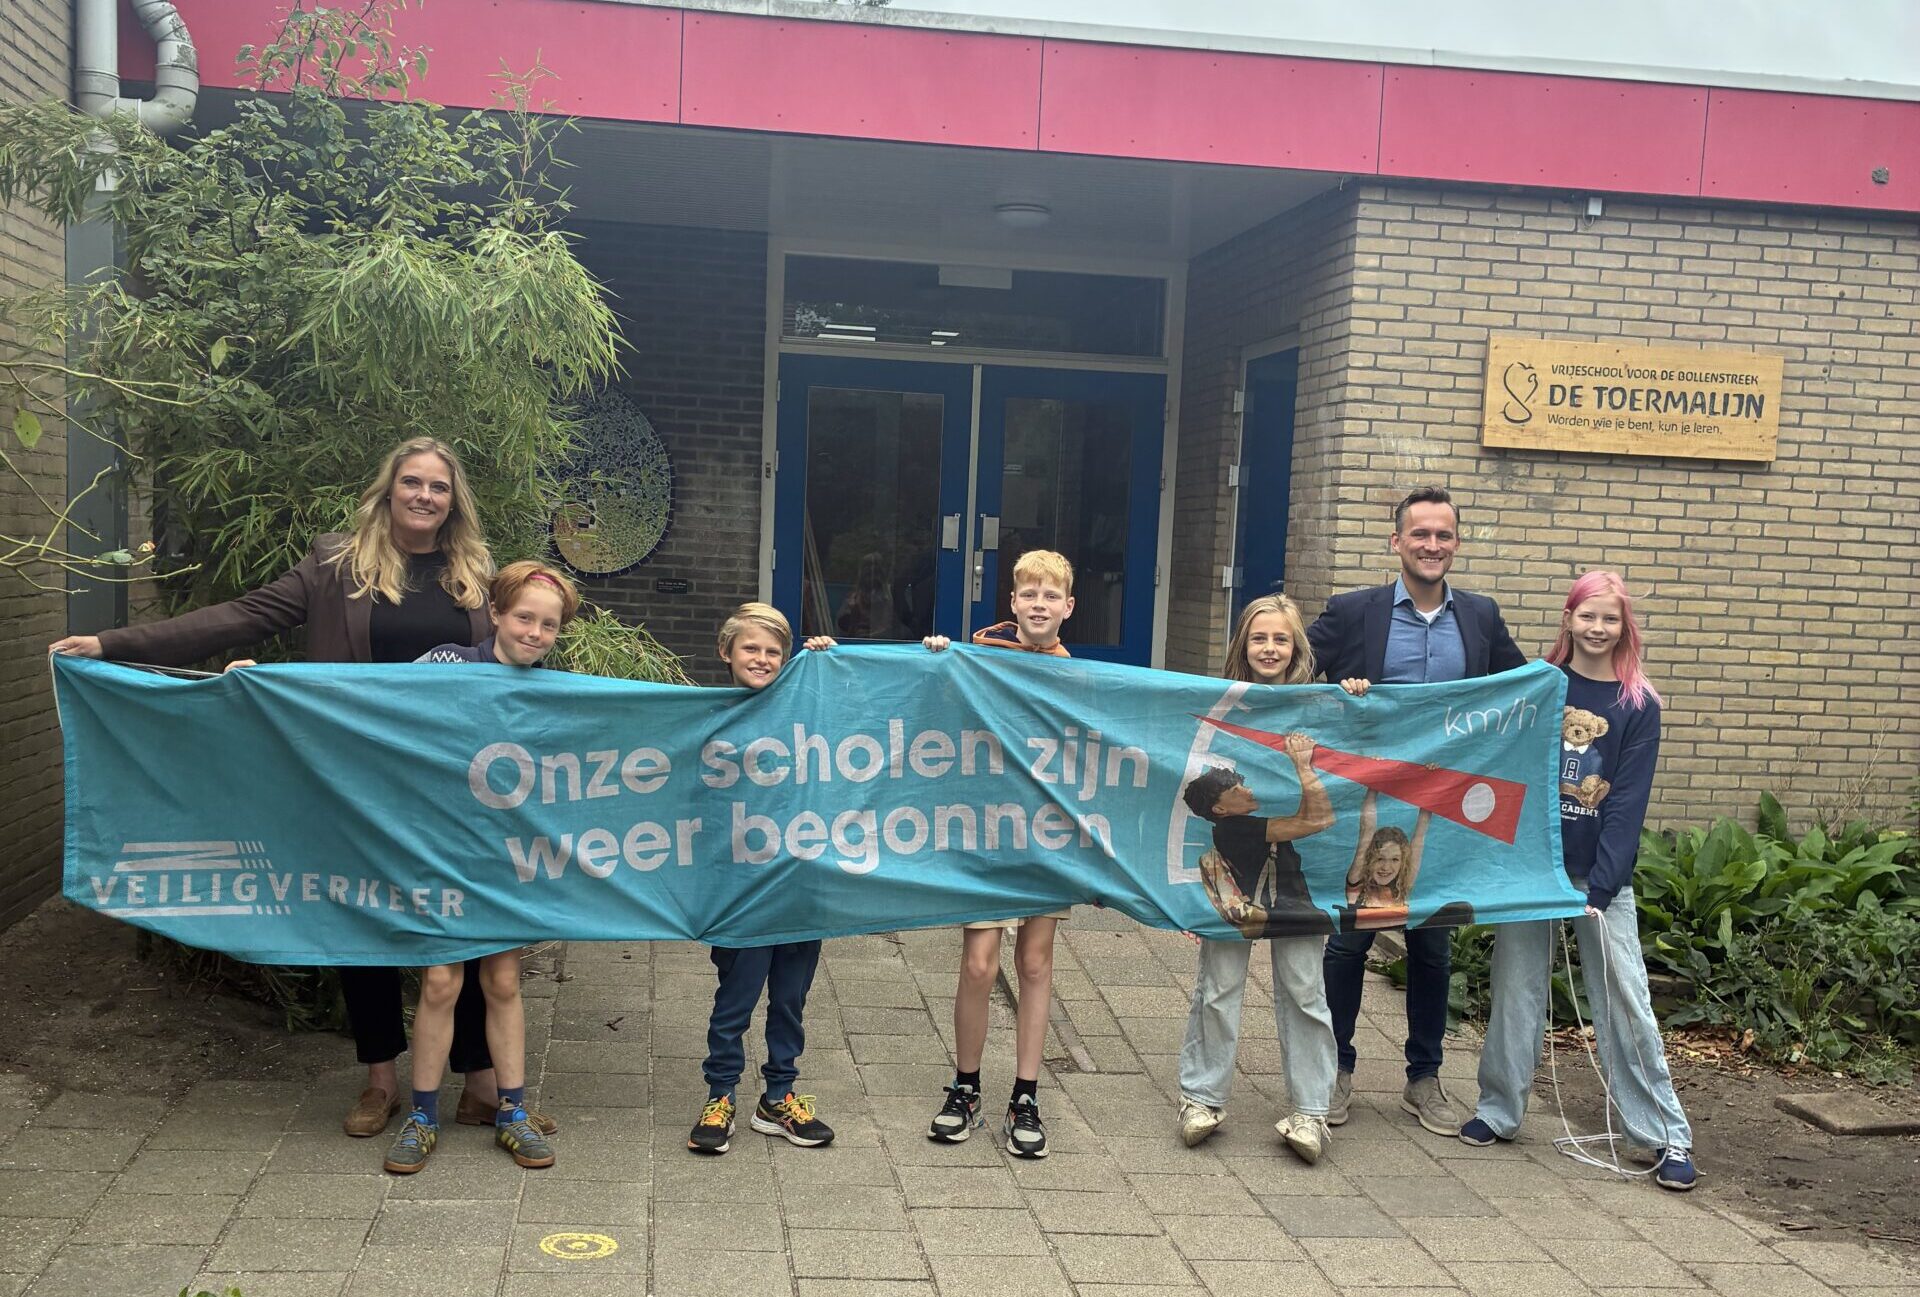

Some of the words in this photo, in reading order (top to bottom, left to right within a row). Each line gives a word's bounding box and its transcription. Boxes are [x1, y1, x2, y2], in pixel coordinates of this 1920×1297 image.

[1551, 364, 1623, 378] VRIJESCHOOL
[1627, 368, 1657, 380] VOOR
[1661, 370, 1675, 381] DE
[1678, 371, 1759, 386] BOLLENSTREEK
[1549, 384, 1583, 408] DE
[1593, 386, 1765, 419] TOERMALIJN
[1547, 413, 1590, 427] Worden
[1593, 418, 1612, 429] wie
[1615, 418, 1625, 432] je
[1627, 418, 1655, 433] bent,
[1659, 421, 1678, 432] kun
[1681, 422, 1691, 435] je
[1693, 422, 1723, 435] leren.
[1444, 697, 1538, 737] km/h
[468, 742, 672, 810] Onze
[701, 719, 1004, 789] scholen
[1027, 726, 1149, 801] zijn
[1561, 803, 1599, 818] CADEMY
[505, 817, 702, 883] weer
[731, 801, 1116, 875] begonnen
